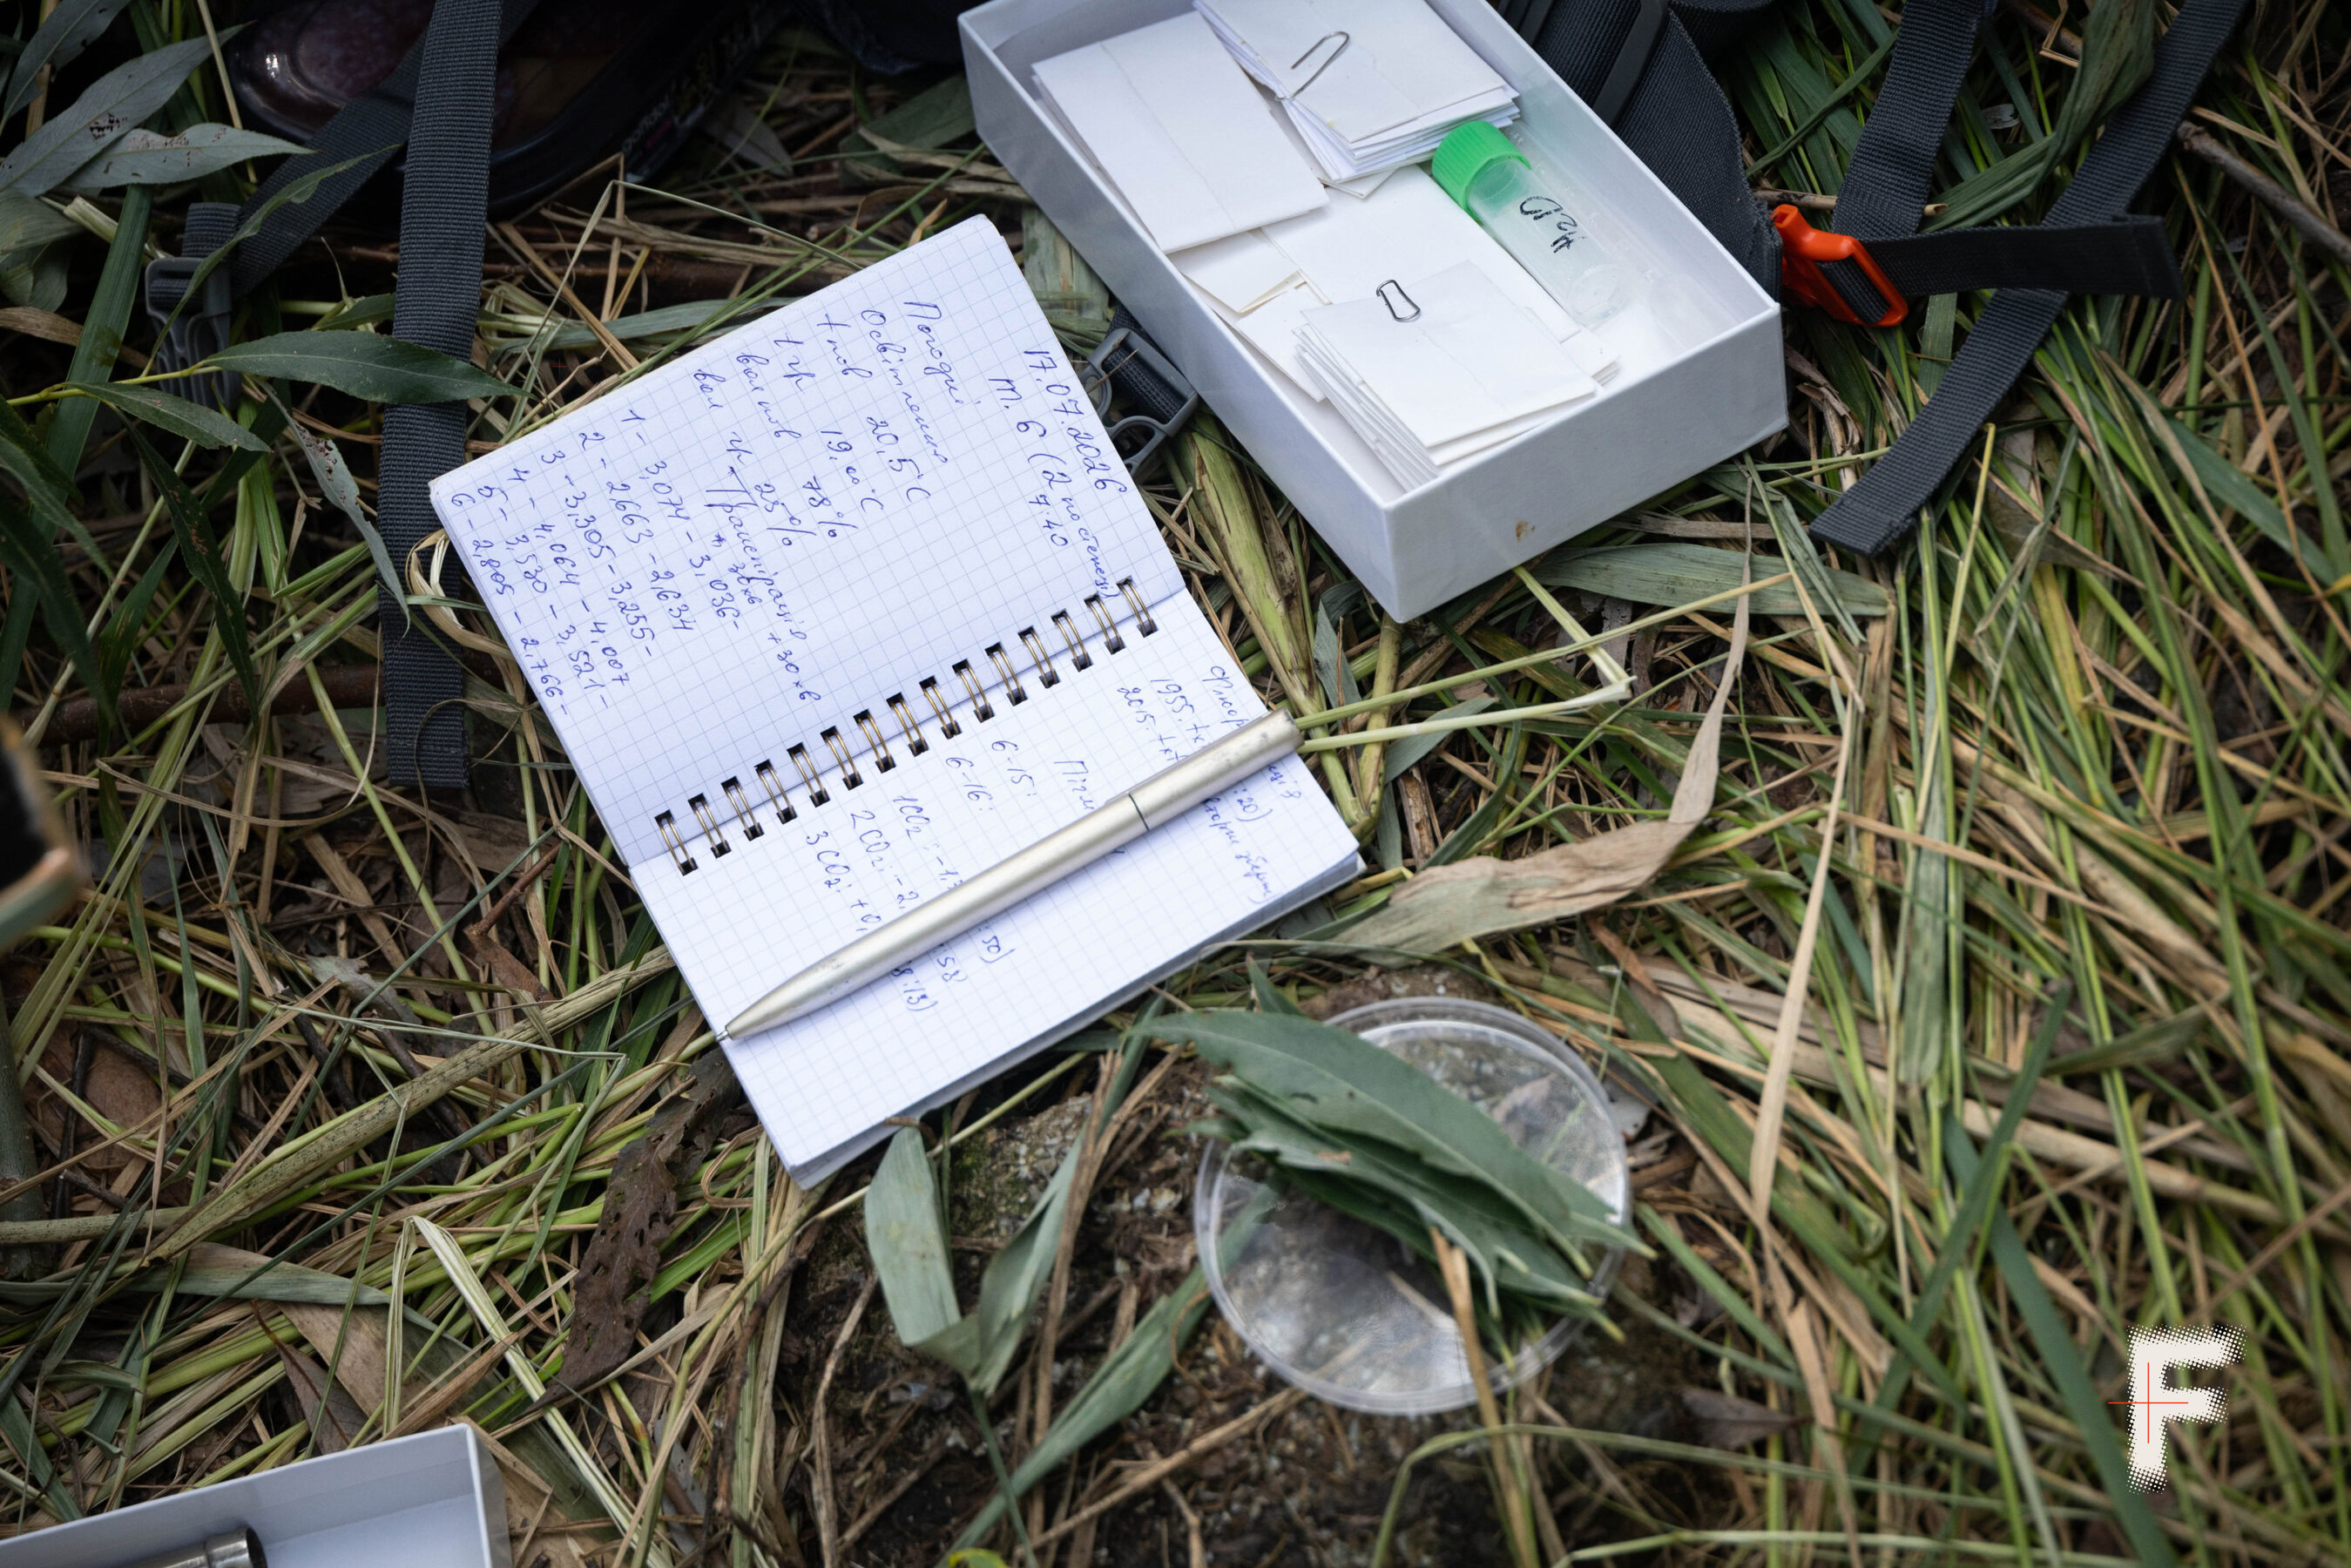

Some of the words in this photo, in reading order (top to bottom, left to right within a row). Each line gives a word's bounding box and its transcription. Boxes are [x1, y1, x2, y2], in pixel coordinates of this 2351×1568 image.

[621, 409, 645, 422] 1
[639, 461, 690, 520] 3,074
[1017, 421, 1047, 437] 6
[1023, 351, 1127, 492] 17.07.2026
[451, 493, 476, 506] 6
[473, 540, 515, 595] 2,805
[521, 638, 564, 697] 2,766
[477, 486, 508, 502] 5
[505, 535, 547, 593] 3,530
[557, 625, 605, 689] 3,521
[508, 468, 530, 483] 4
[534, 524, 579, 585] 4,064
[591, 622, 630, 686] 4,007
[541, 450, 565, 463] 3
[565, 491, 616, 558] 3,305
[608, 582, 655, 640] 3,255
[578, 432, 605, 450] 2
[606, 482, 653, 544] 2,663
[651, 571, 696, 630] 2,634
[1029, 495, 1068, 546] 7:40
